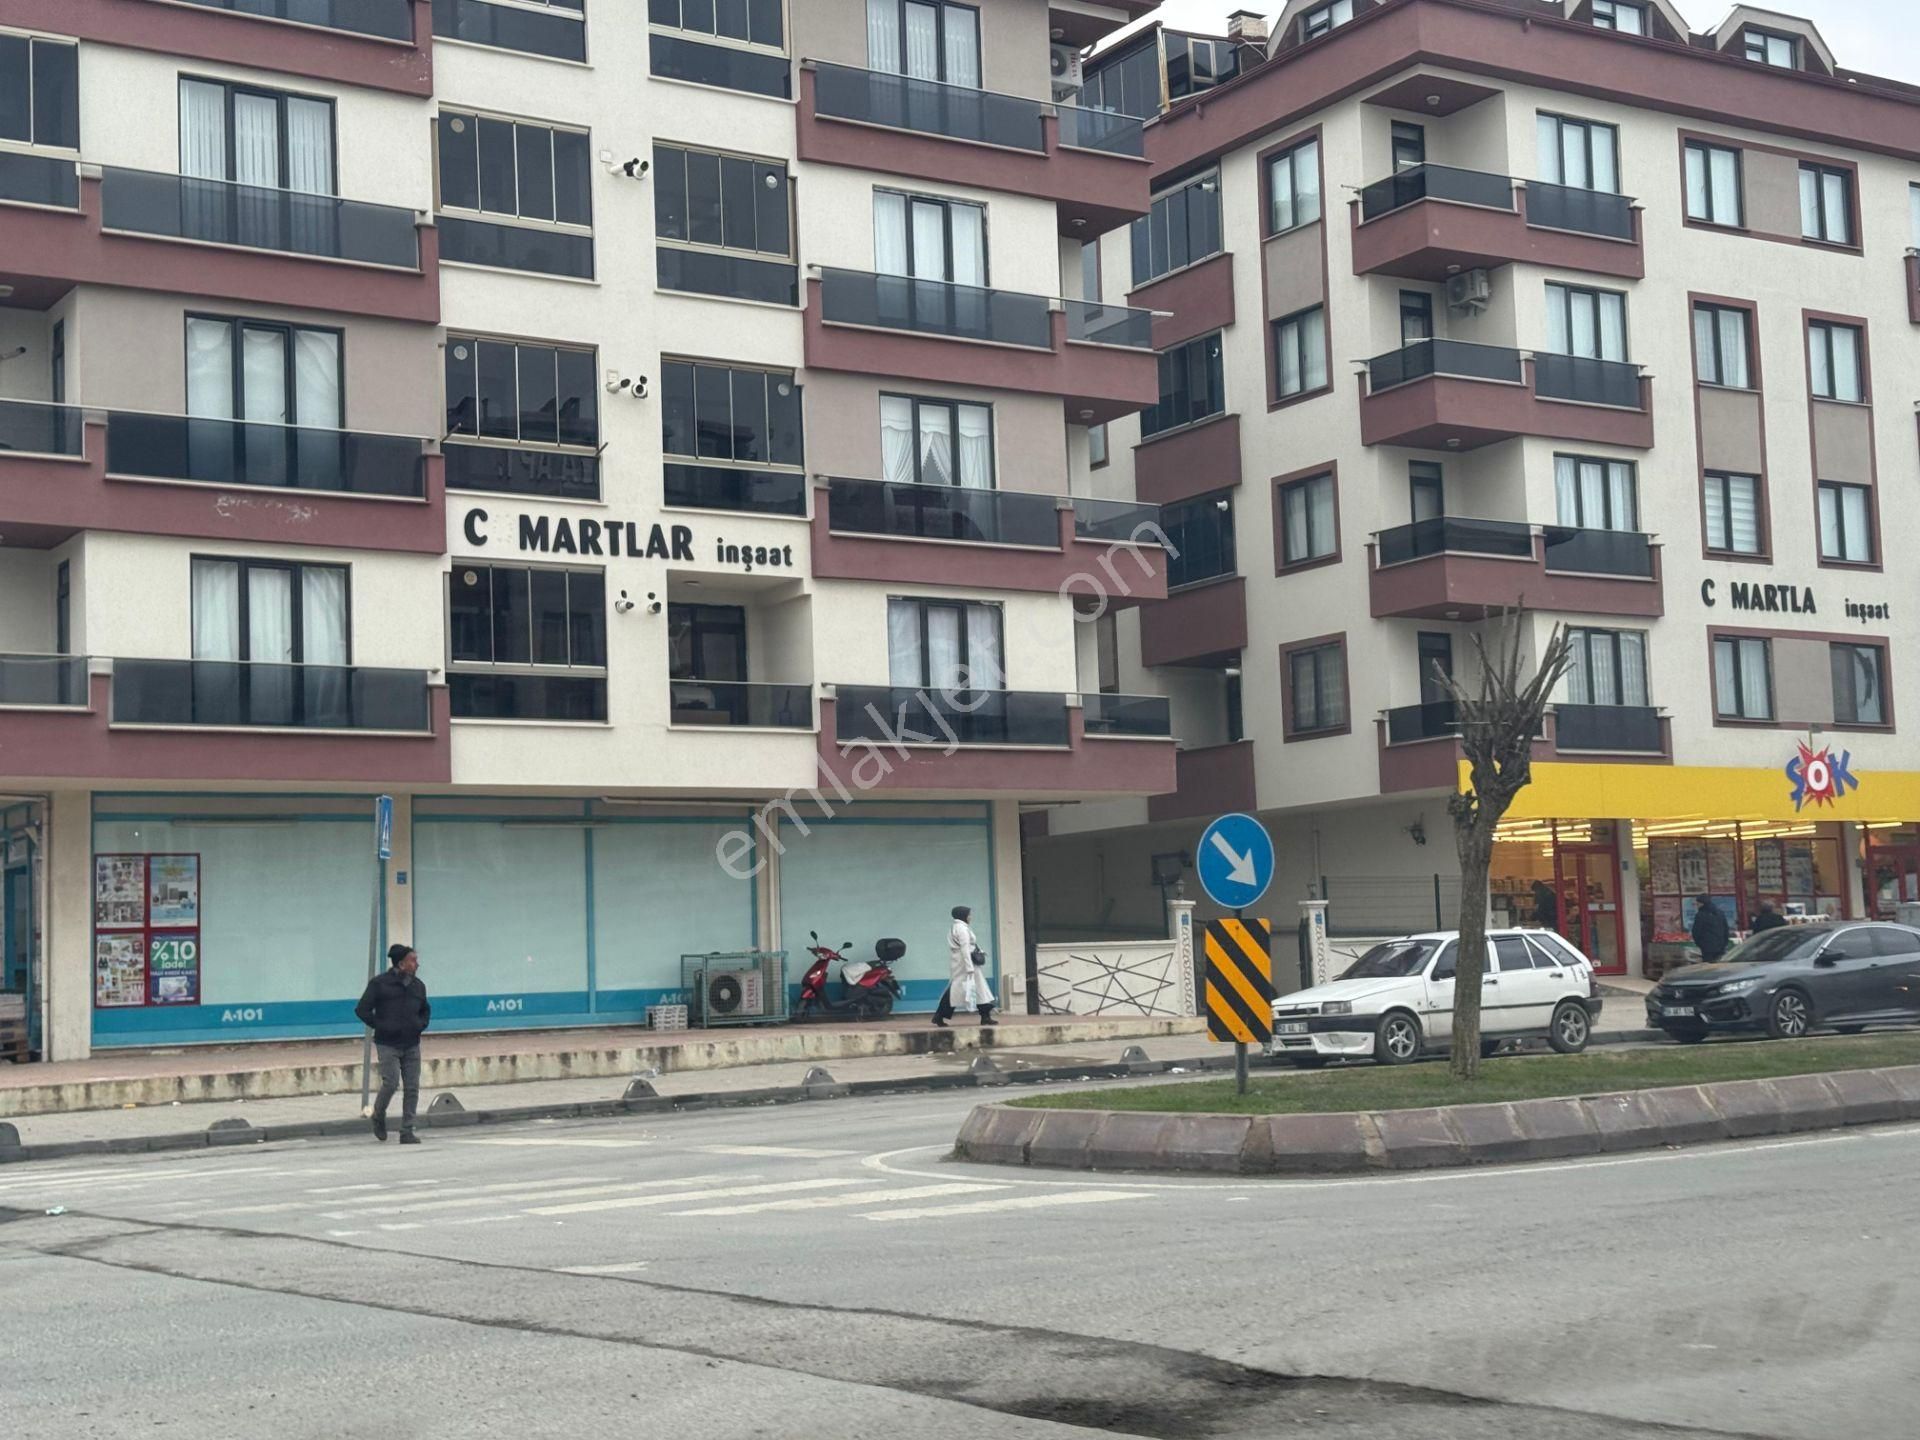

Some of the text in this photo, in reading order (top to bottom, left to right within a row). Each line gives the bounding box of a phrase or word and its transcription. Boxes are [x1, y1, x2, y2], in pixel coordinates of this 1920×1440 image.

[464, 508, 793, 572] C MARTLAR inşaat
[1701, 578, 1890, 623] C MARTLA inşaat
[152, 941, 196, 961] %10
